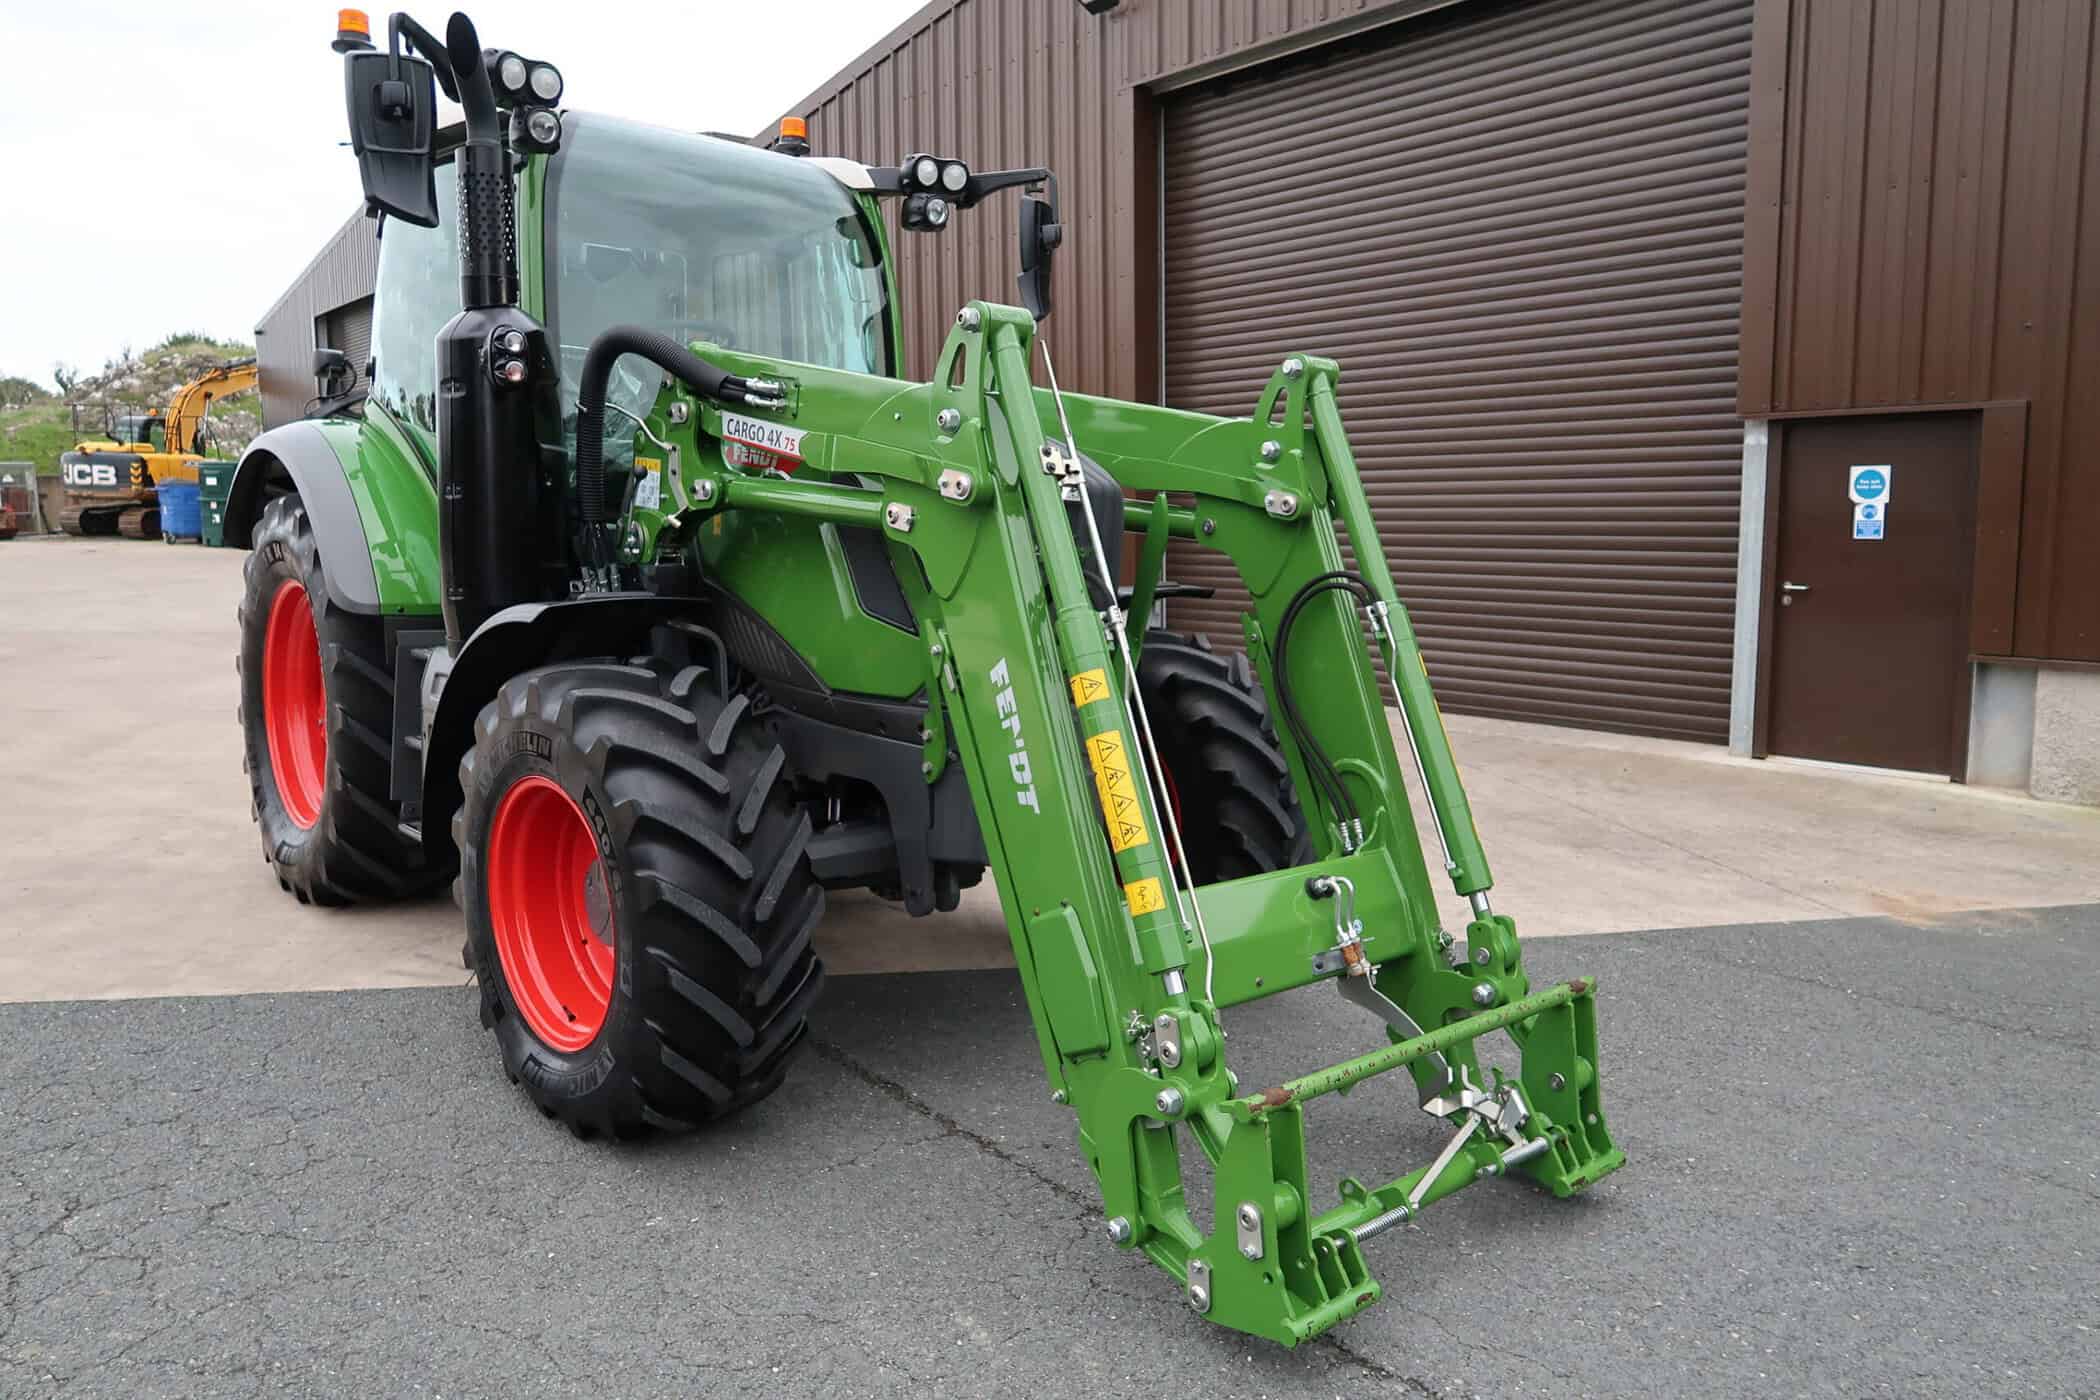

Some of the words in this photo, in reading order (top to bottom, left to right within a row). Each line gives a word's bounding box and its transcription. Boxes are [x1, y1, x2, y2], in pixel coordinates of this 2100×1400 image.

[726, 418, 765, 441] CARGO
[767, 429, 783, 448] 4X
[784, 436, 796, 452] 75
[63, 463, 118, 486] JCB
[990, 657, 1041, 815] FENDT
